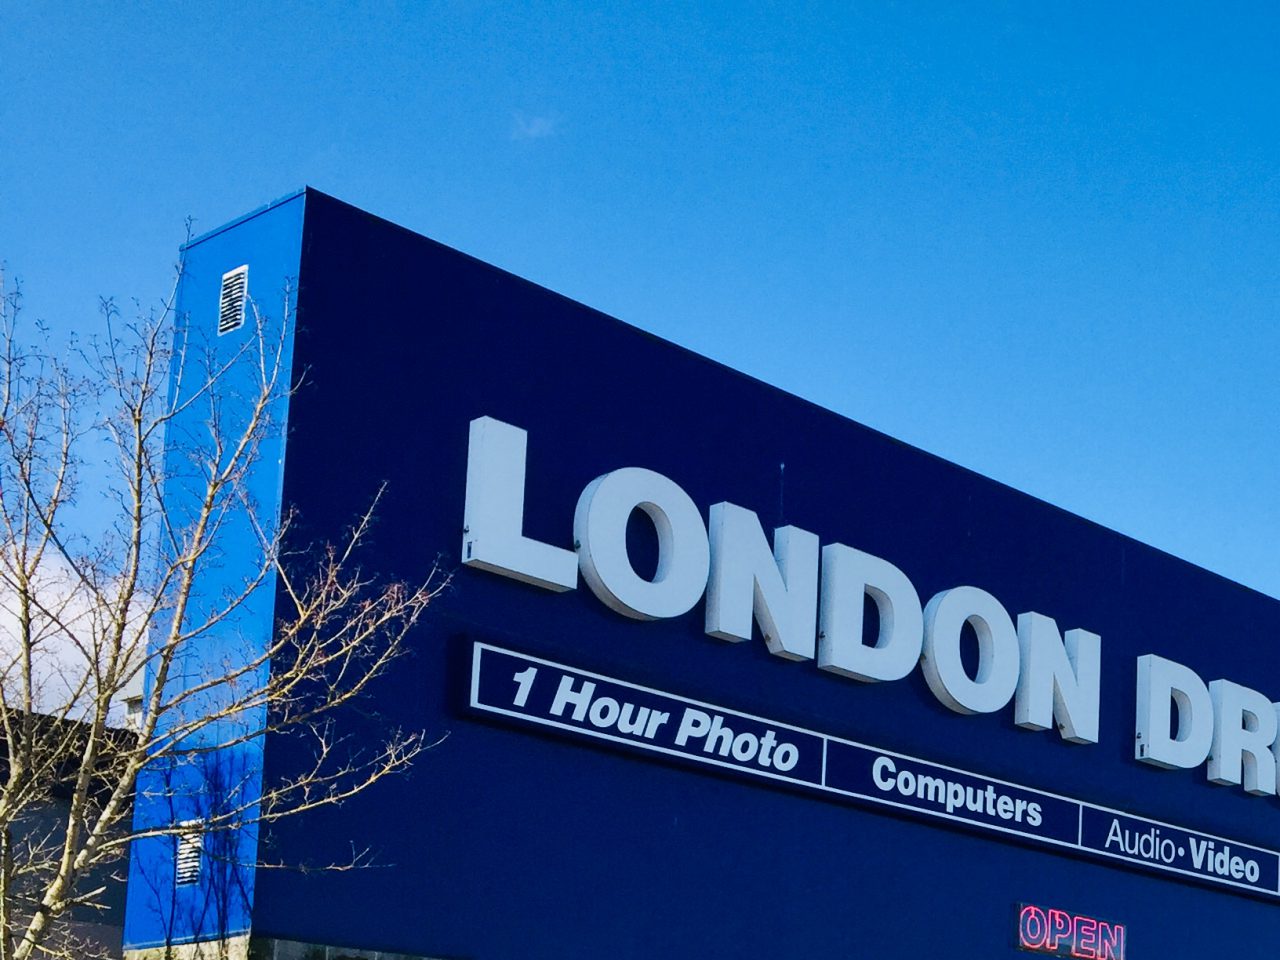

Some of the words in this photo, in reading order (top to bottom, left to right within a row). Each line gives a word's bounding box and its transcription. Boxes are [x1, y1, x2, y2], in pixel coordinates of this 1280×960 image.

[461, 415, 1102, 744] LONDON
[512, 666, 539, 708] 1
[549, 674, 669, 741] Hour
[674, 704, 800, 772] Photo
[872, 756, 1043, 827] Computers
